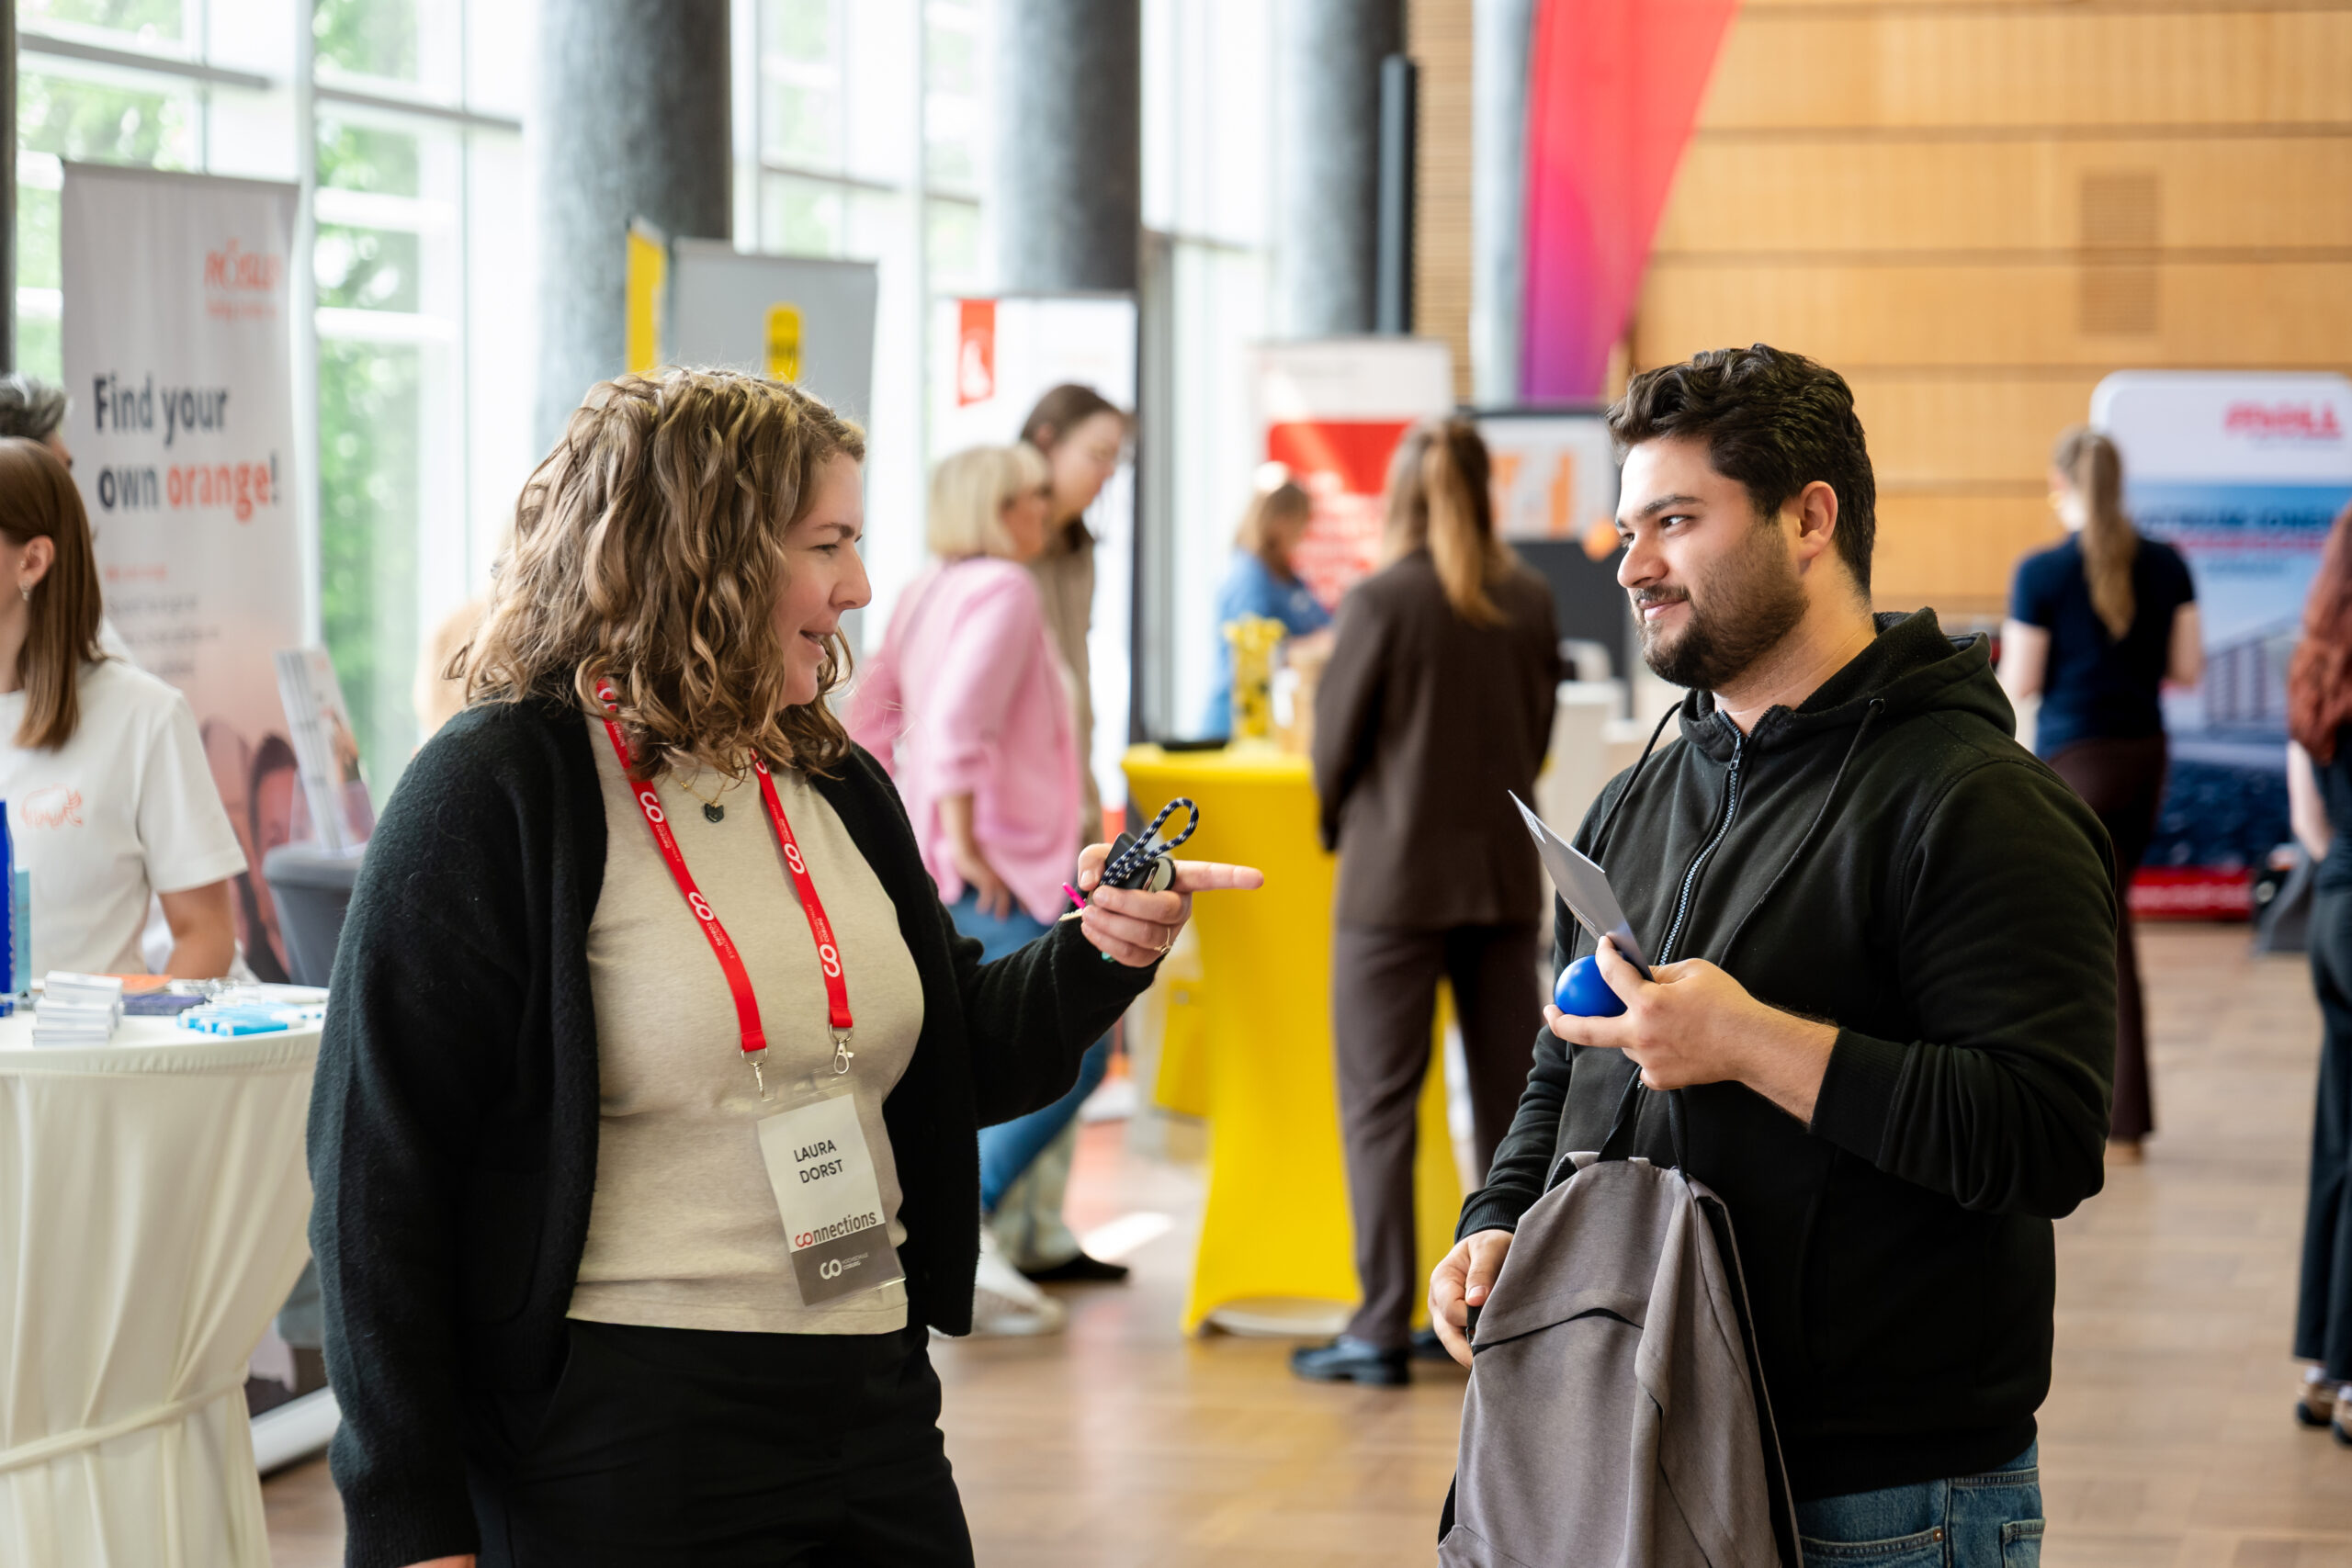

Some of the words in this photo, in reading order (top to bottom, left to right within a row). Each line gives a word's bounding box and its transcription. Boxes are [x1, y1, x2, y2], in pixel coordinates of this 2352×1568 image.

[94, 372, 152, 432] Find
[161, 387, 228, 449] your
[98, 466, 157, 509] own
[166, 452, 279, 525] orange!
[793, 1139, 837, 1163] LAURA
[798, 1158, 843, 1184] DORST
